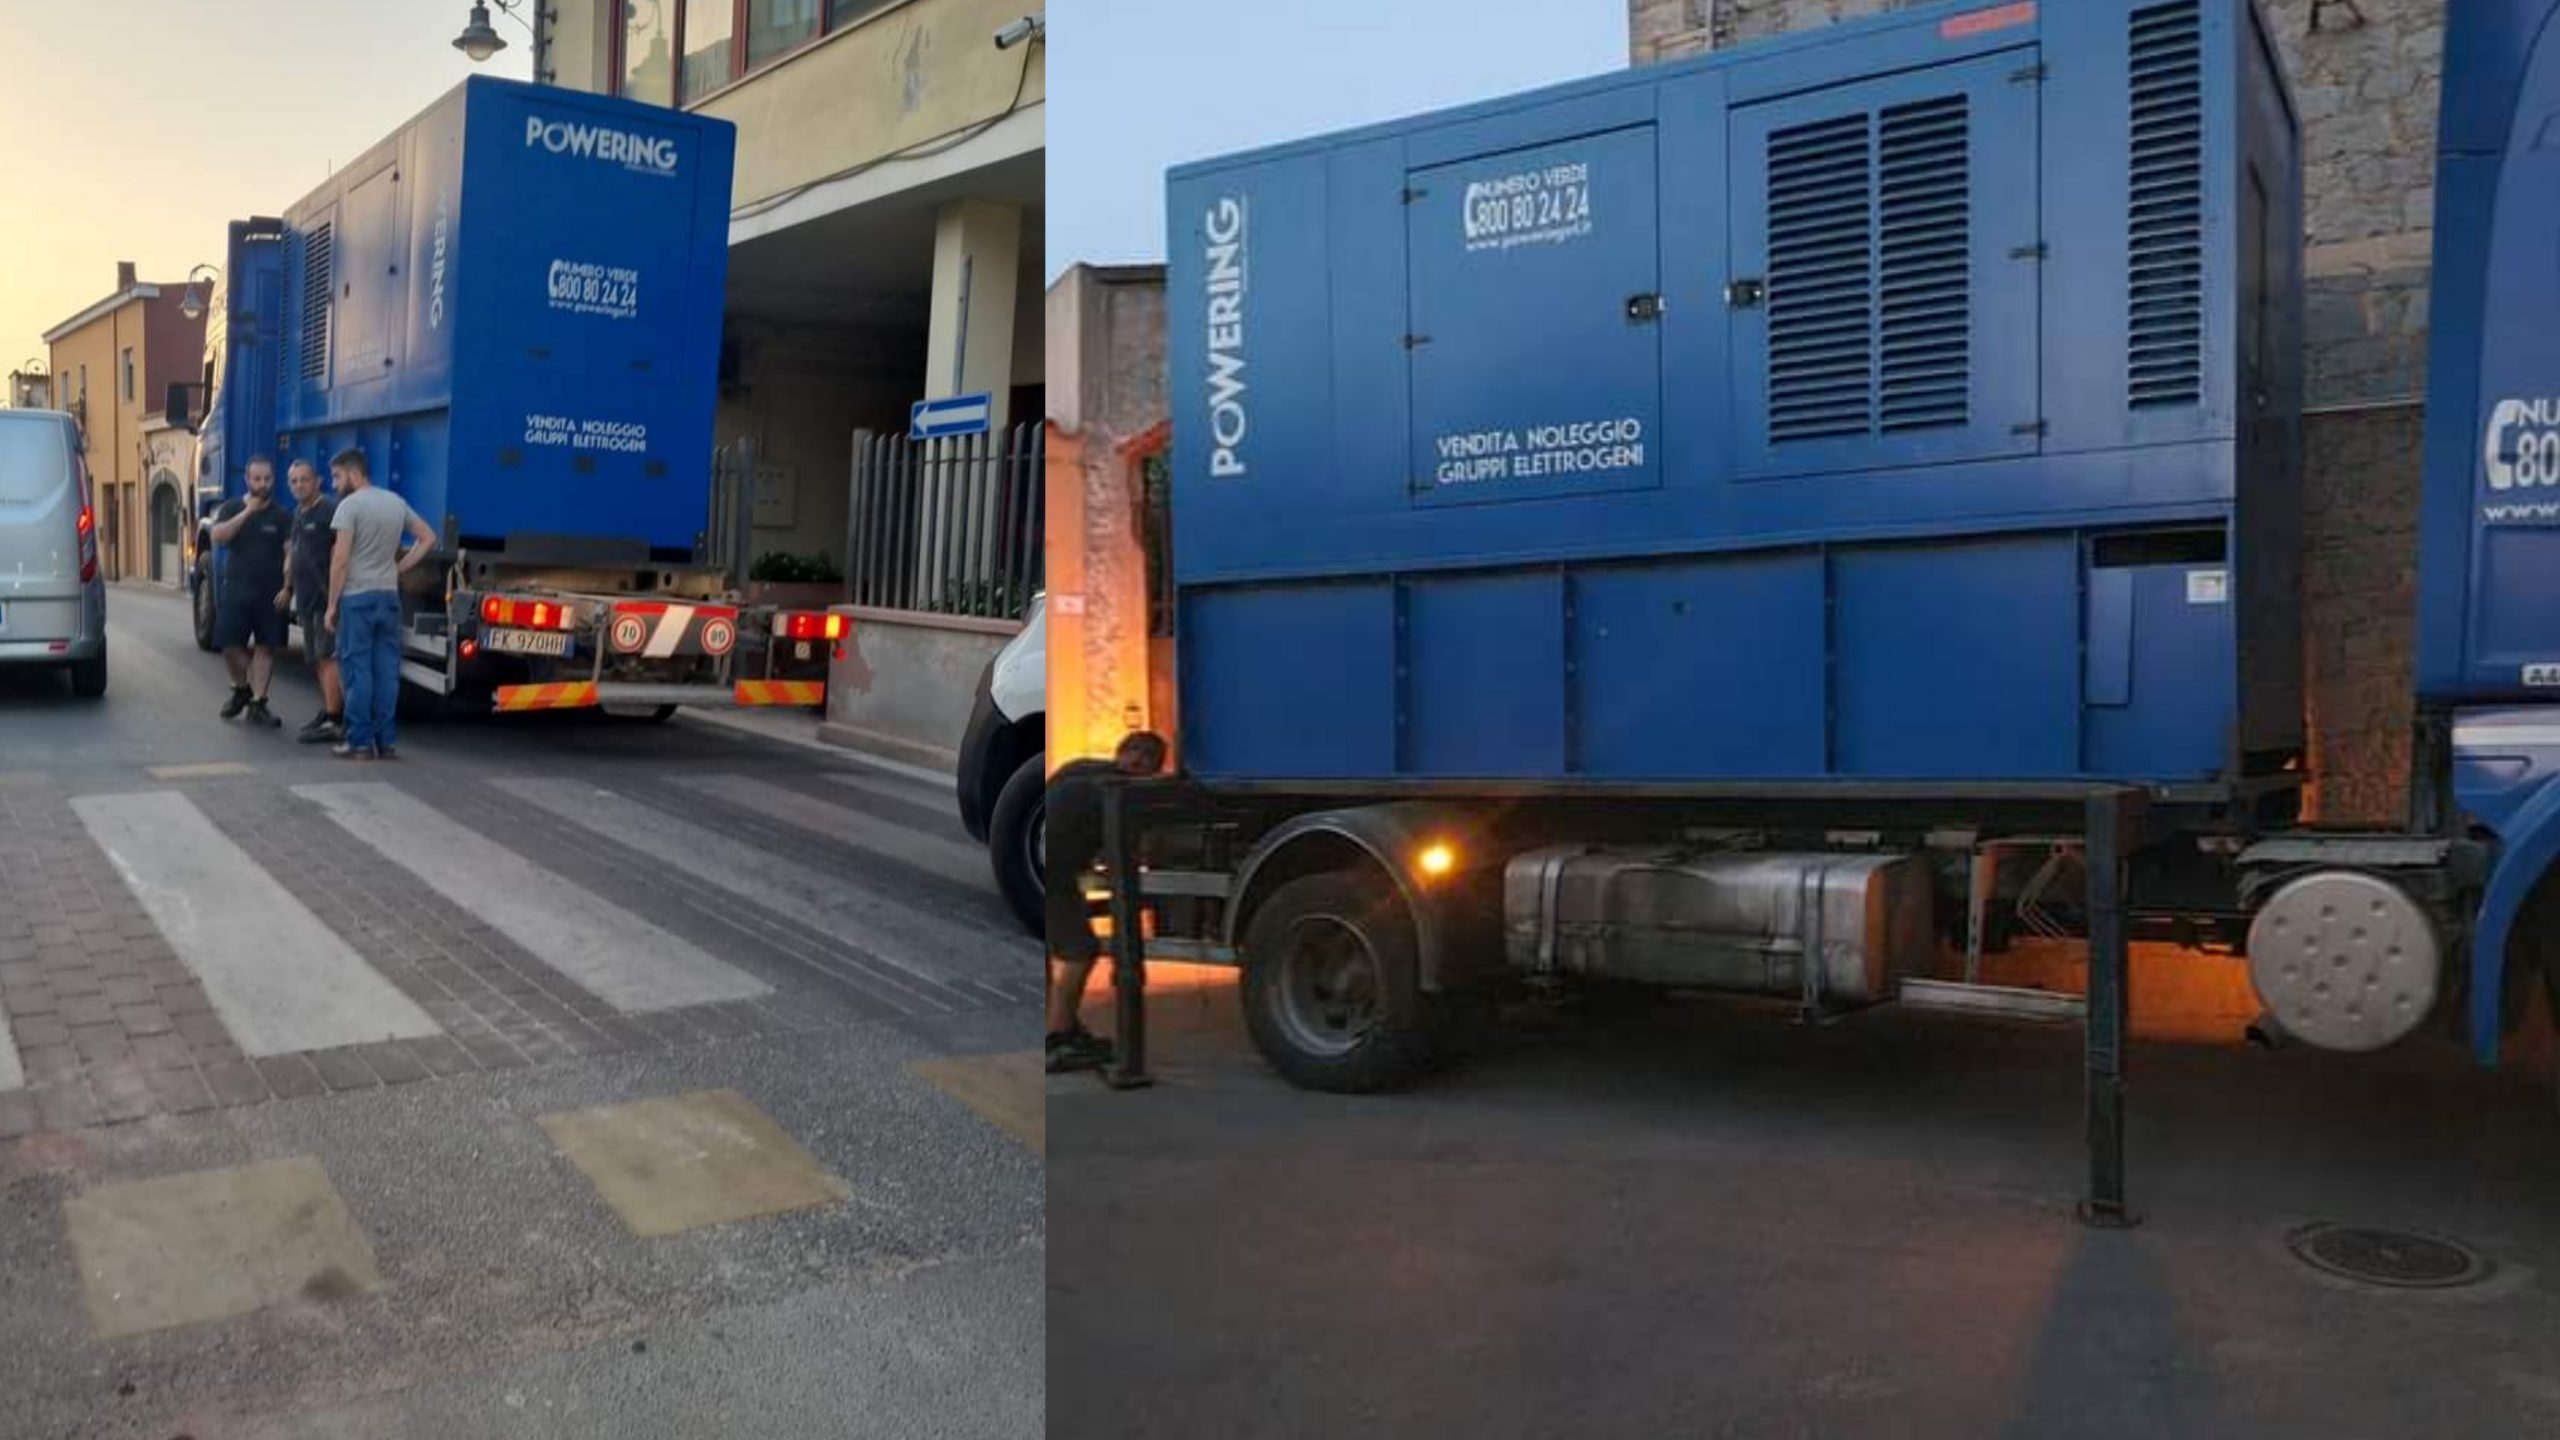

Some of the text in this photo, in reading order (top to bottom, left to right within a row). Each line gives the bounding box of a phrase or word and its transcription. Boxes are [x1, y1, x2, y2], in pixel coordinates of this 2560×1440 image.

[526, 115, 678, 169] POWERING
[1480, 163, 1587, 199] NUMERO VERDE
[1477, 182, 1589, 235] 800 80 24 24
[559, 261, 638, 284] NUMERO VERDE
[559, 274, 637, 308] 800 80 24 24
[1206, 198, 1246, 476] POWERING
[525, 429, 646, 453] GRUPPI ELETTROGENI
[526, 414, 646, 438] VENDITA NOLEGGIO
[1437, 418, 1641, 458] VENDITA NOLEGGIO
[1437, 443, 1644, 484] GRUPPI ELETTROGENI
[622, 624, 637, 640] 70
